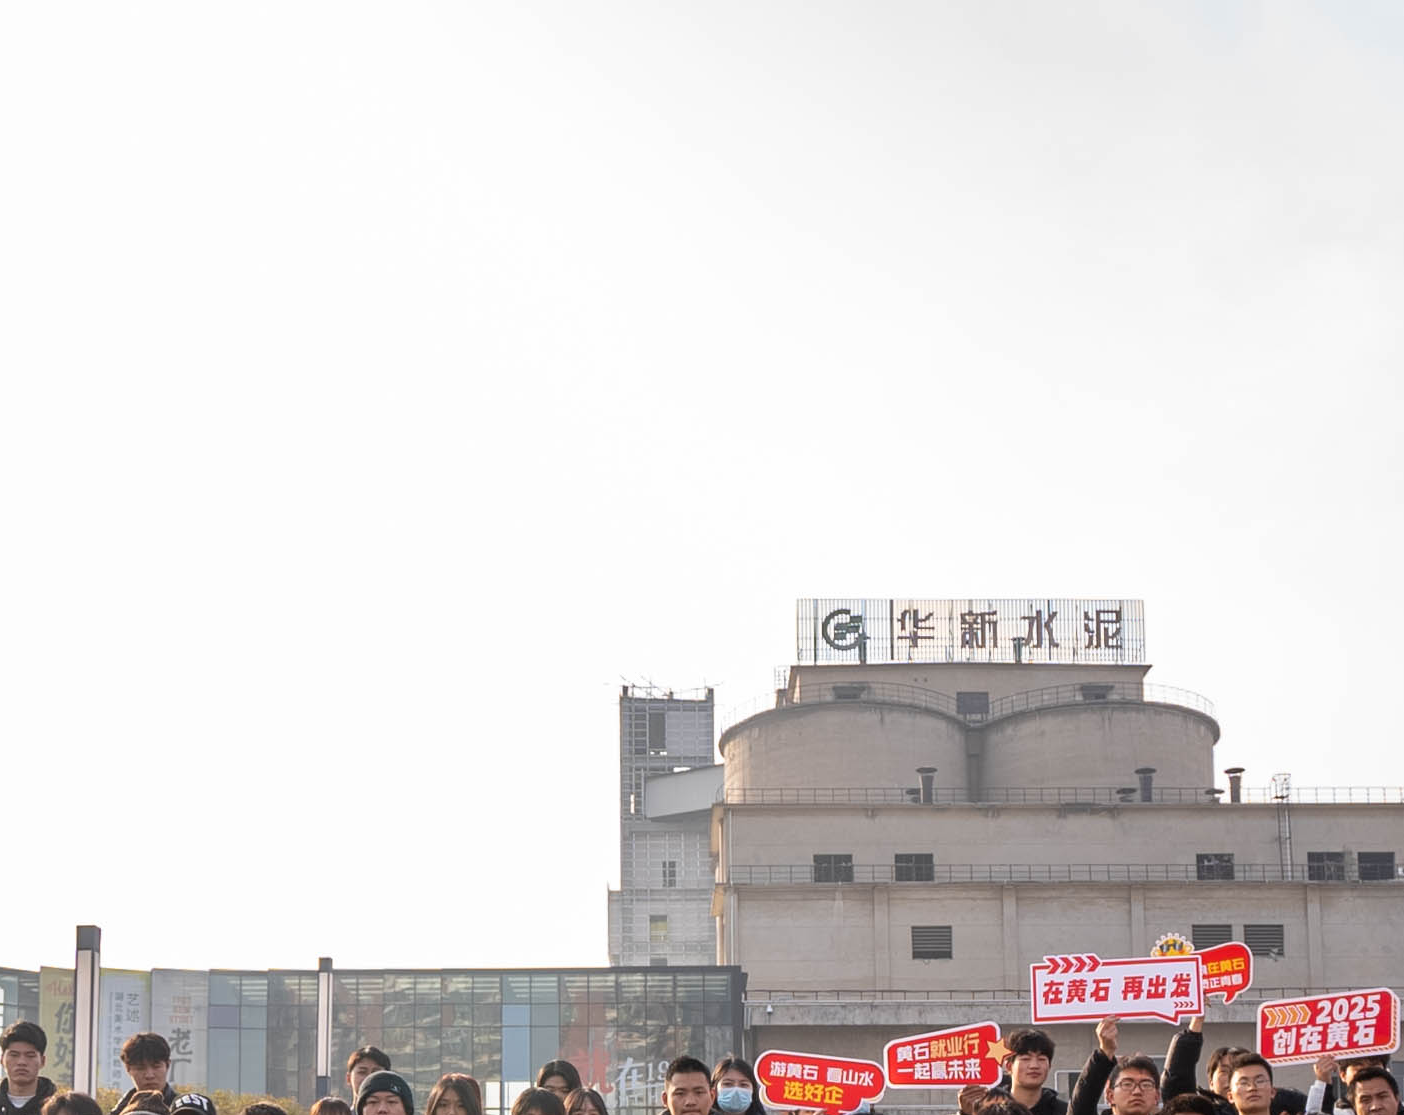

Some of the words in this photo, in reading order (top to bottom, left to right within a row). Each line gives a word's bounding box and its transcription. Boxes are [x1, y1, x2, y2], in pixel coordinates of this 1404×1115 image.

[897, 608, 1123, 649] 华新水泥
[1202, 957, 1245, 975] 在黄石
[1042, 977, 1111, 1006] 在黄石
[1122, 972, 1192, 1001] 再出发
[1315, 994, 1381, 1025] 2025
[896, 1033, 980, 1063] 黄石就业行
[1272, 1018, 1377, 1056] 创在黄石
[770, 1061, 819, 1080] 游黄石
[896, 1058, 982, 1081] 一起赢未来
[783, 1080, 844, 1105] 选好企
